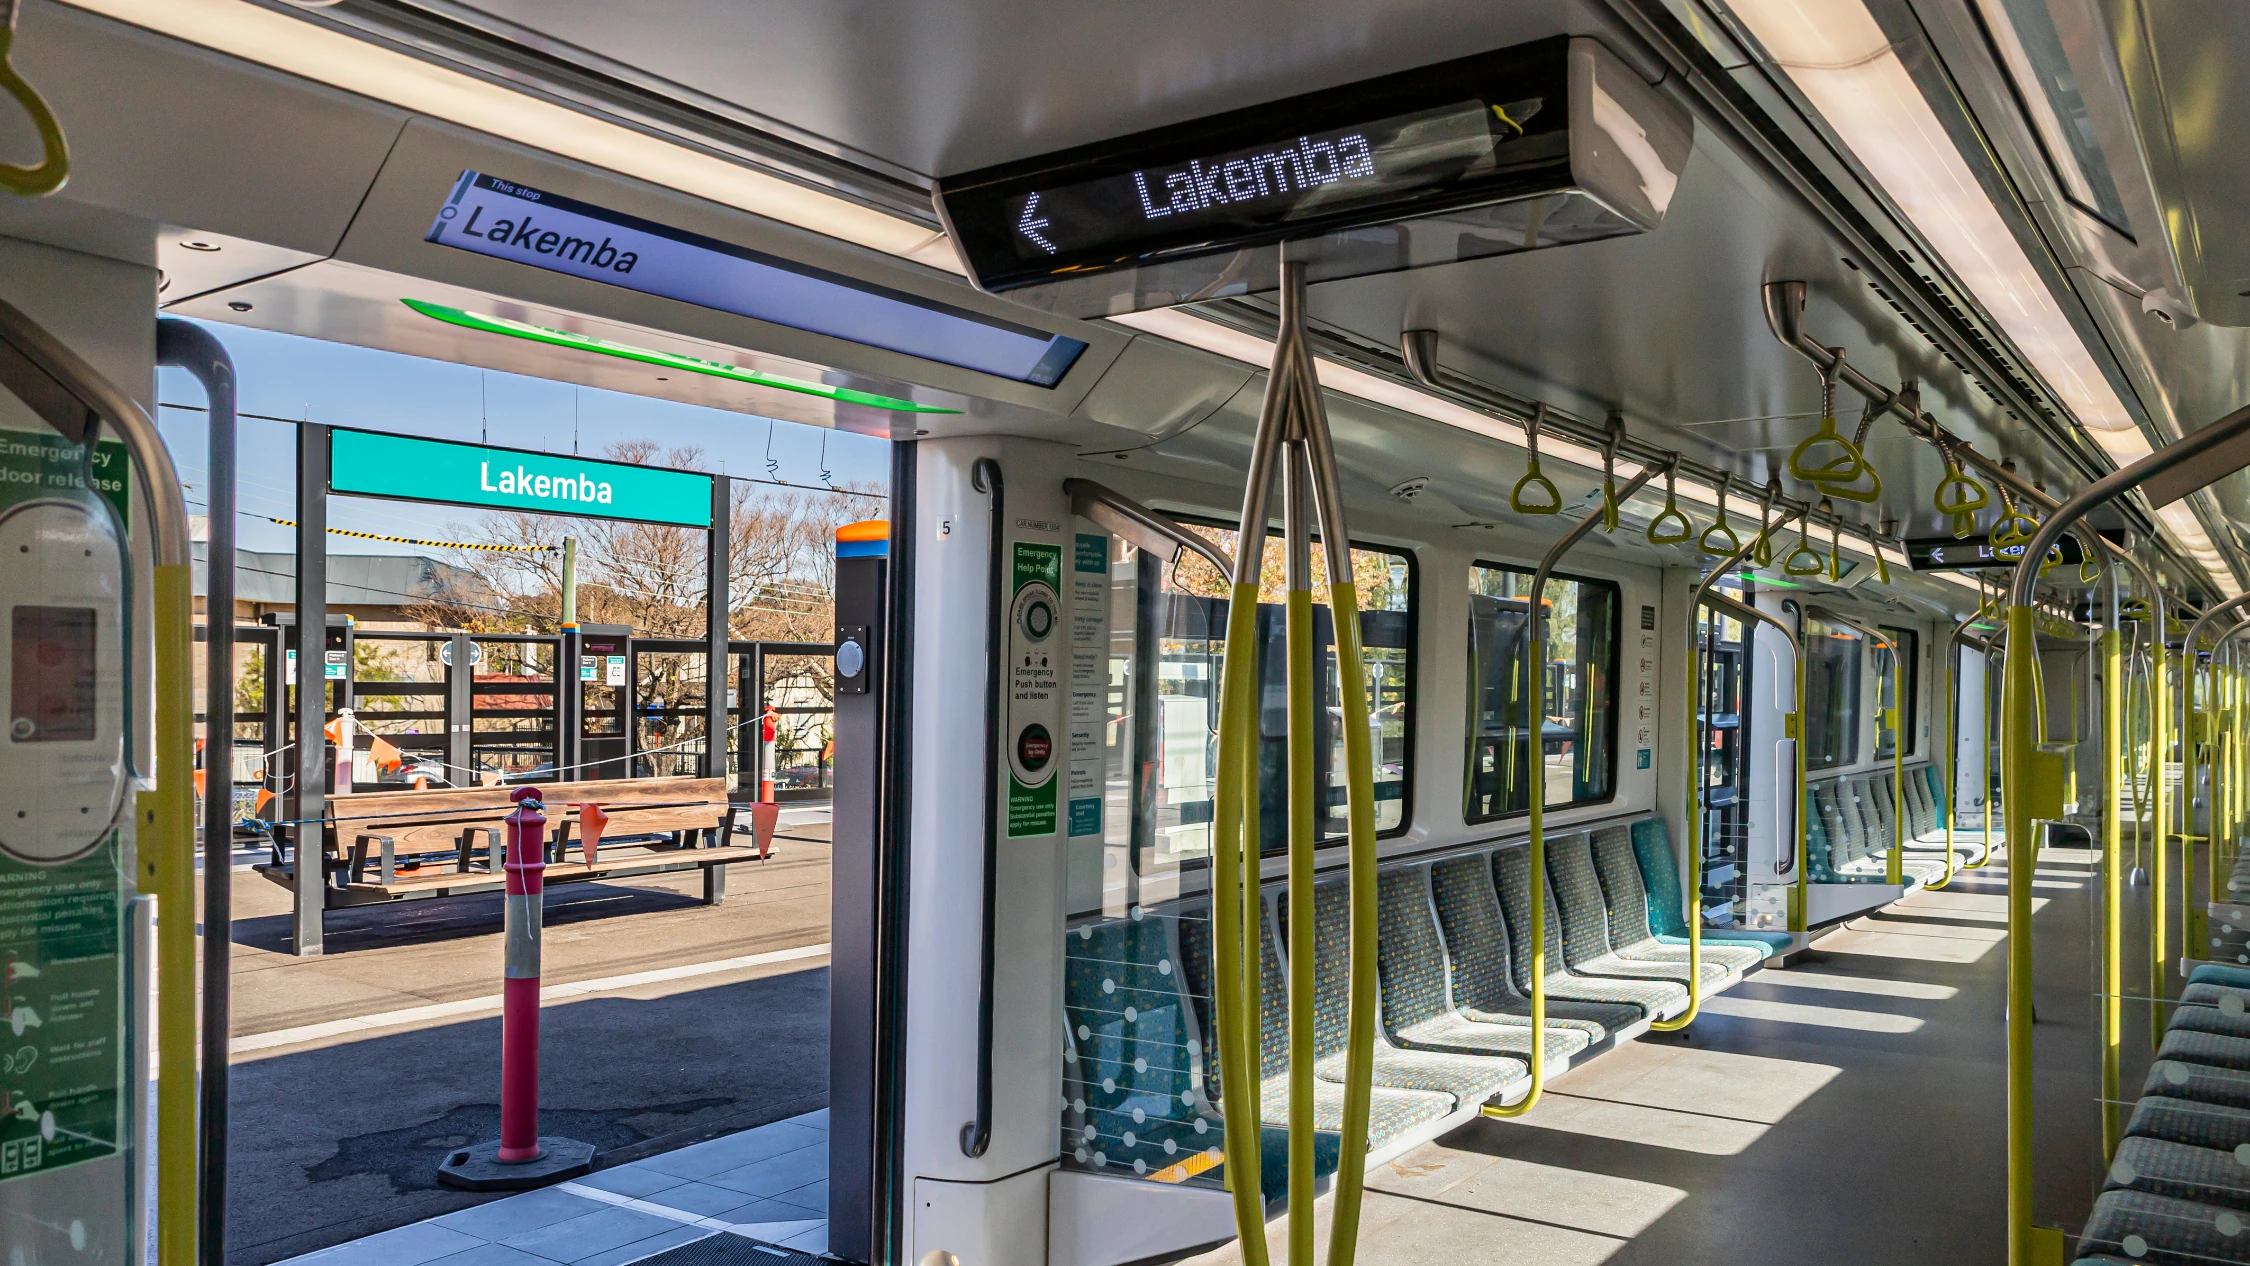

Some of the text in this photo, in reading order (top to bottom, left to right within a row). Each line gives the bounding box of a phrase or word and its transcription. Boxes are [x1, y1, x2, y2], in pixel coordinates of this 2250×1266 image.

[1134, 134, 1374, 220] Lakemba
[492, 178, 540, 200] This stop
[462, 206, 639, 274] Lakemba
[481, 462, 612, 504] Lakemba
[942, 521, 950, 535] 5
[1018, 547, 1057, 560] Emergency
[1018, 562, 1034, 574] Help
[1016, 667, 1054, 678] Emergency
[1015, 680, 1056, 688] Push button
[1015, 692, 1048, 700] and listen
